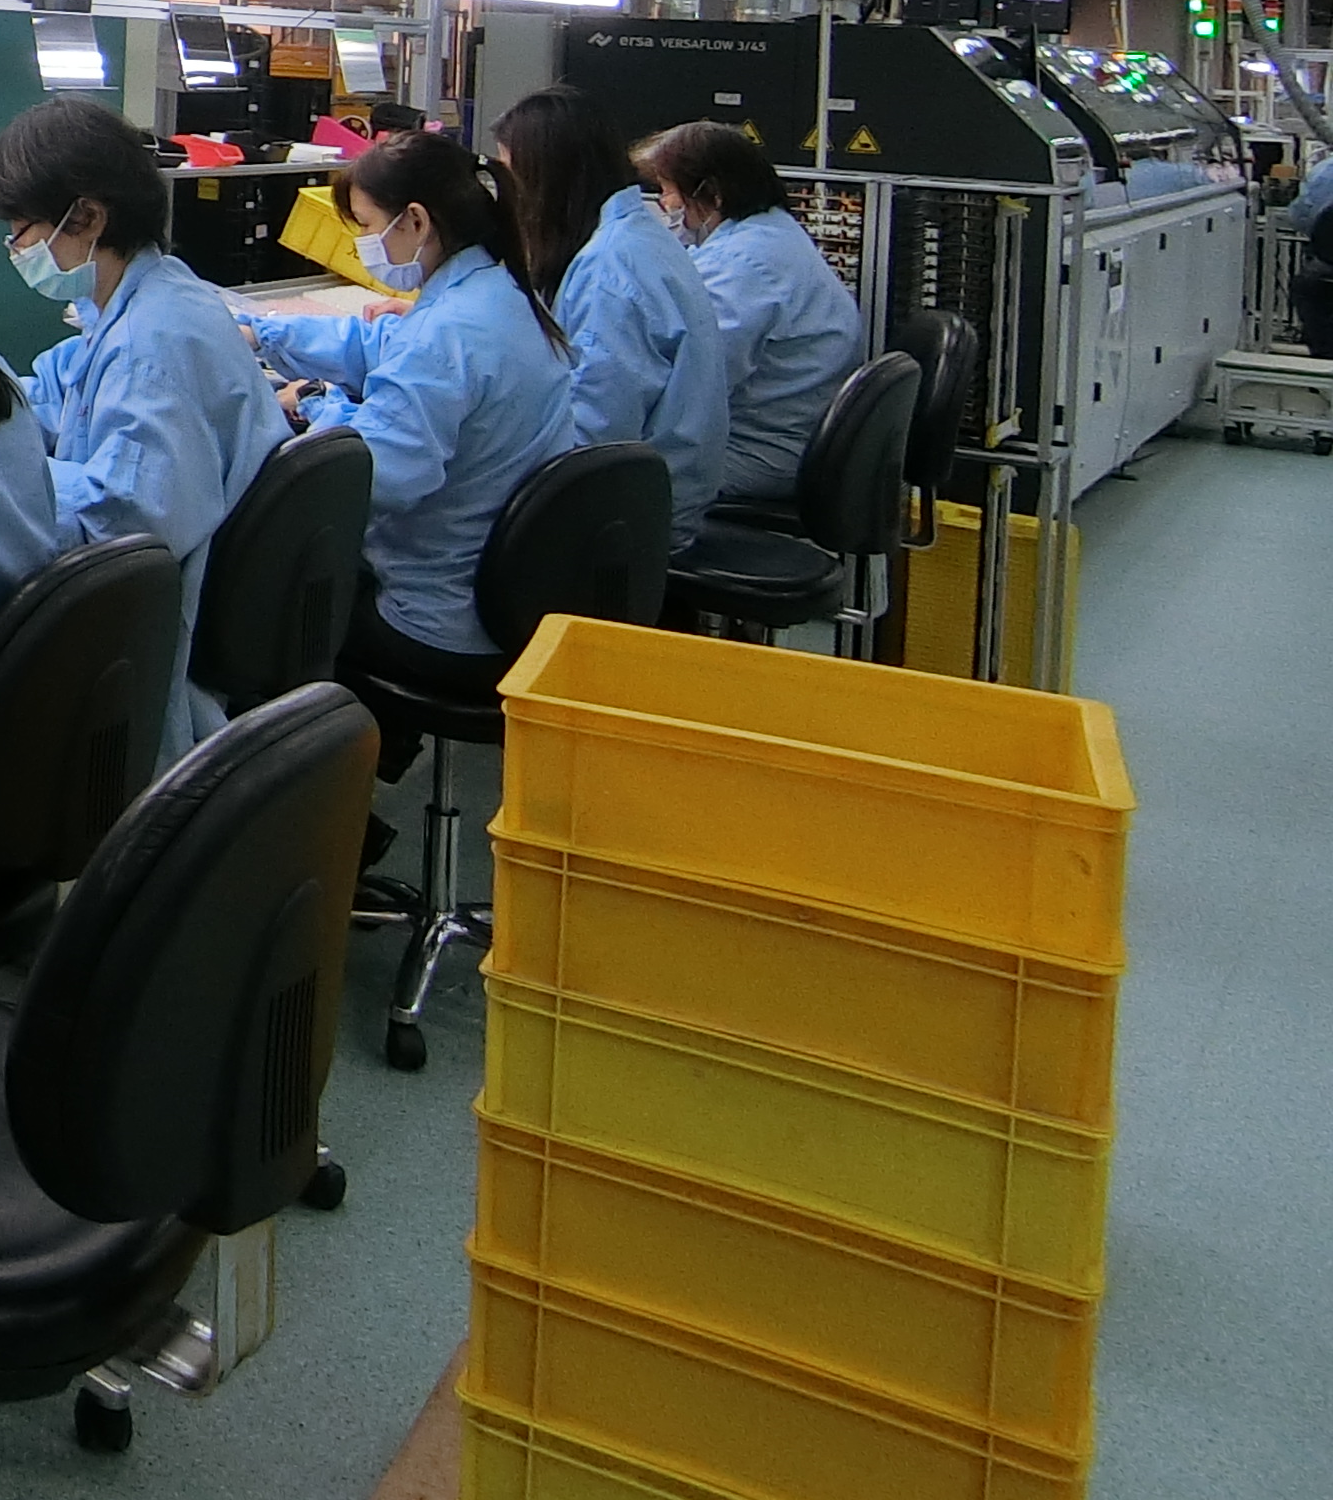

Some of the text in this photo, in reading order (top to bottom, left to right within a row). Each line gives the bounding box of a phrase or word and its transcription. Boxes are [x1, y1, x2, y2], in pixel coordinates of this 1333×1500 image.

[619, 35, 767, 52] ersa VERSAFLOW 3/45
